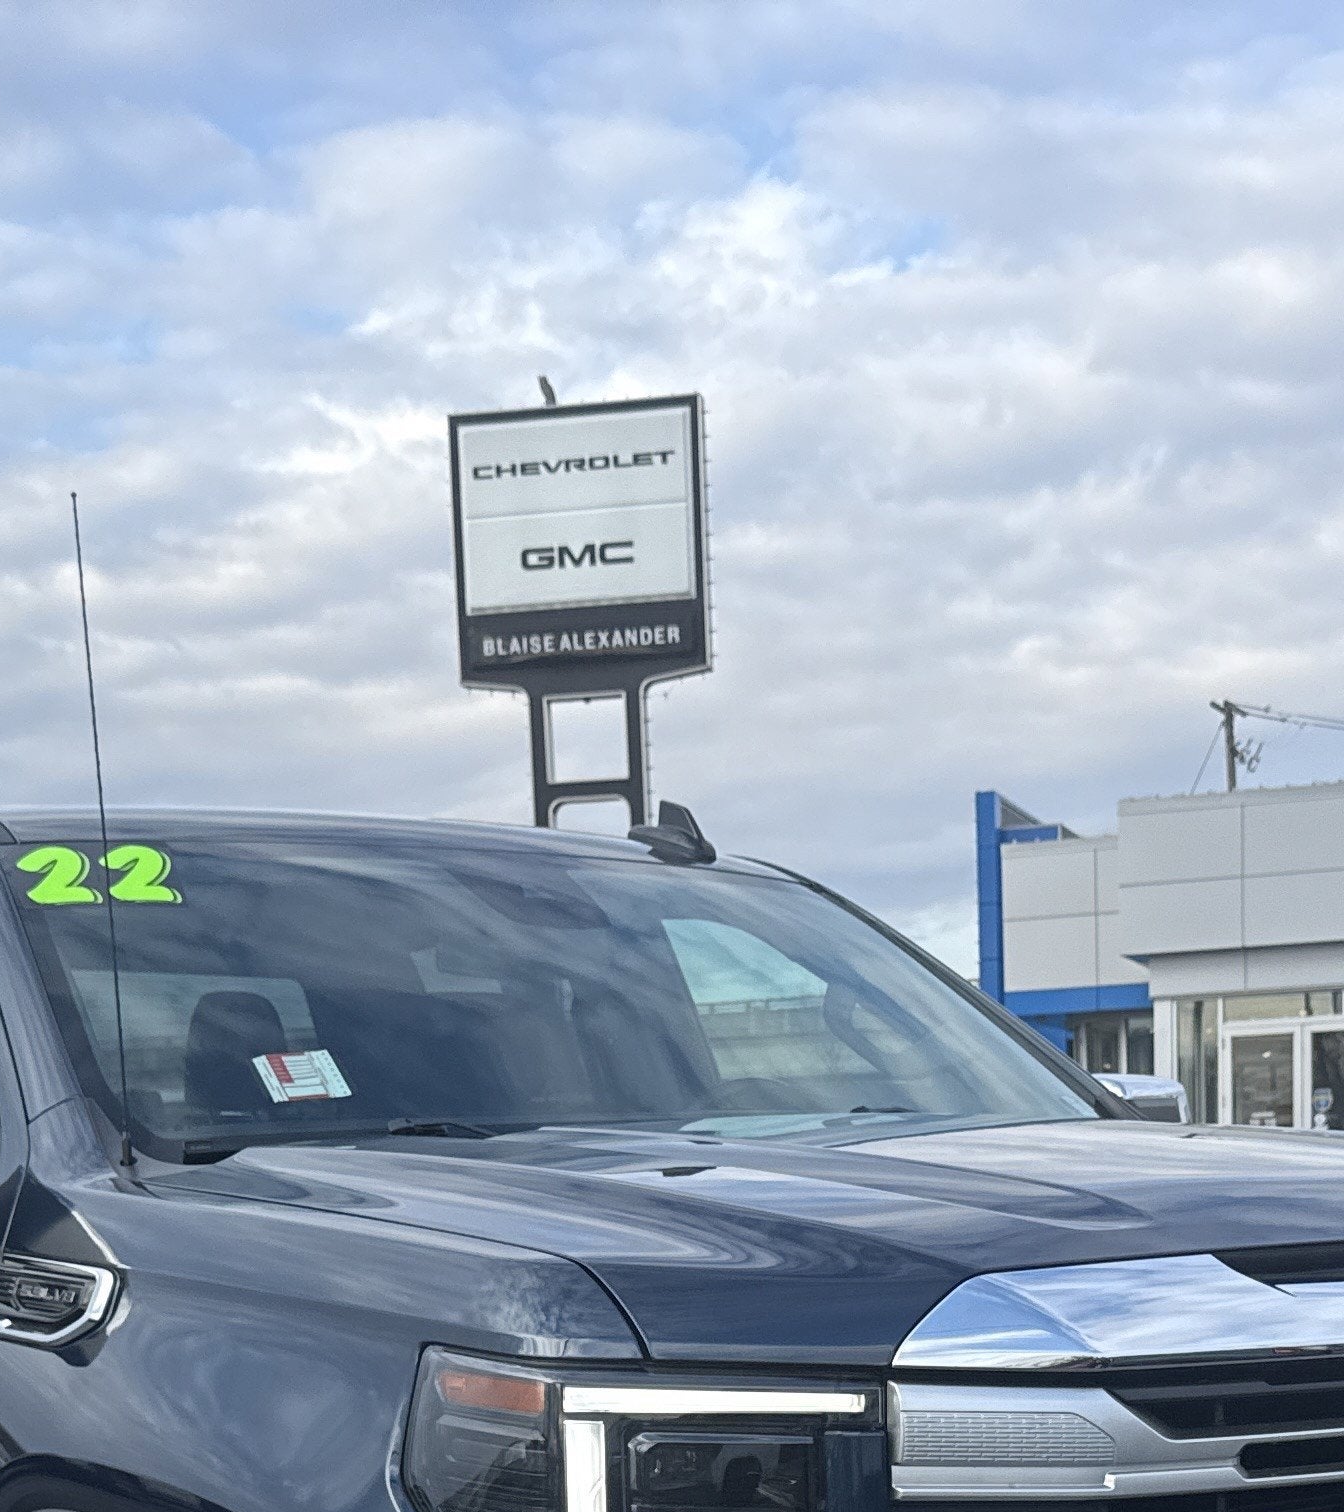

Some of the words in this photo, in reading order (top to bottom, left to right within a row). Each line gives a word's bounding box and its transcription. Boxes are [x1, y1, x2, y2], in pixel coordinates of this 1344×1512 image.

[472, 449, 675, 480] CHEVROLET
[520, 540, 635, 571] GMC
[482, 631, 556, 657] BLAISE
[558, 624, 681, 653] ALEXANDER
[16, 845, 184, 904] 22
